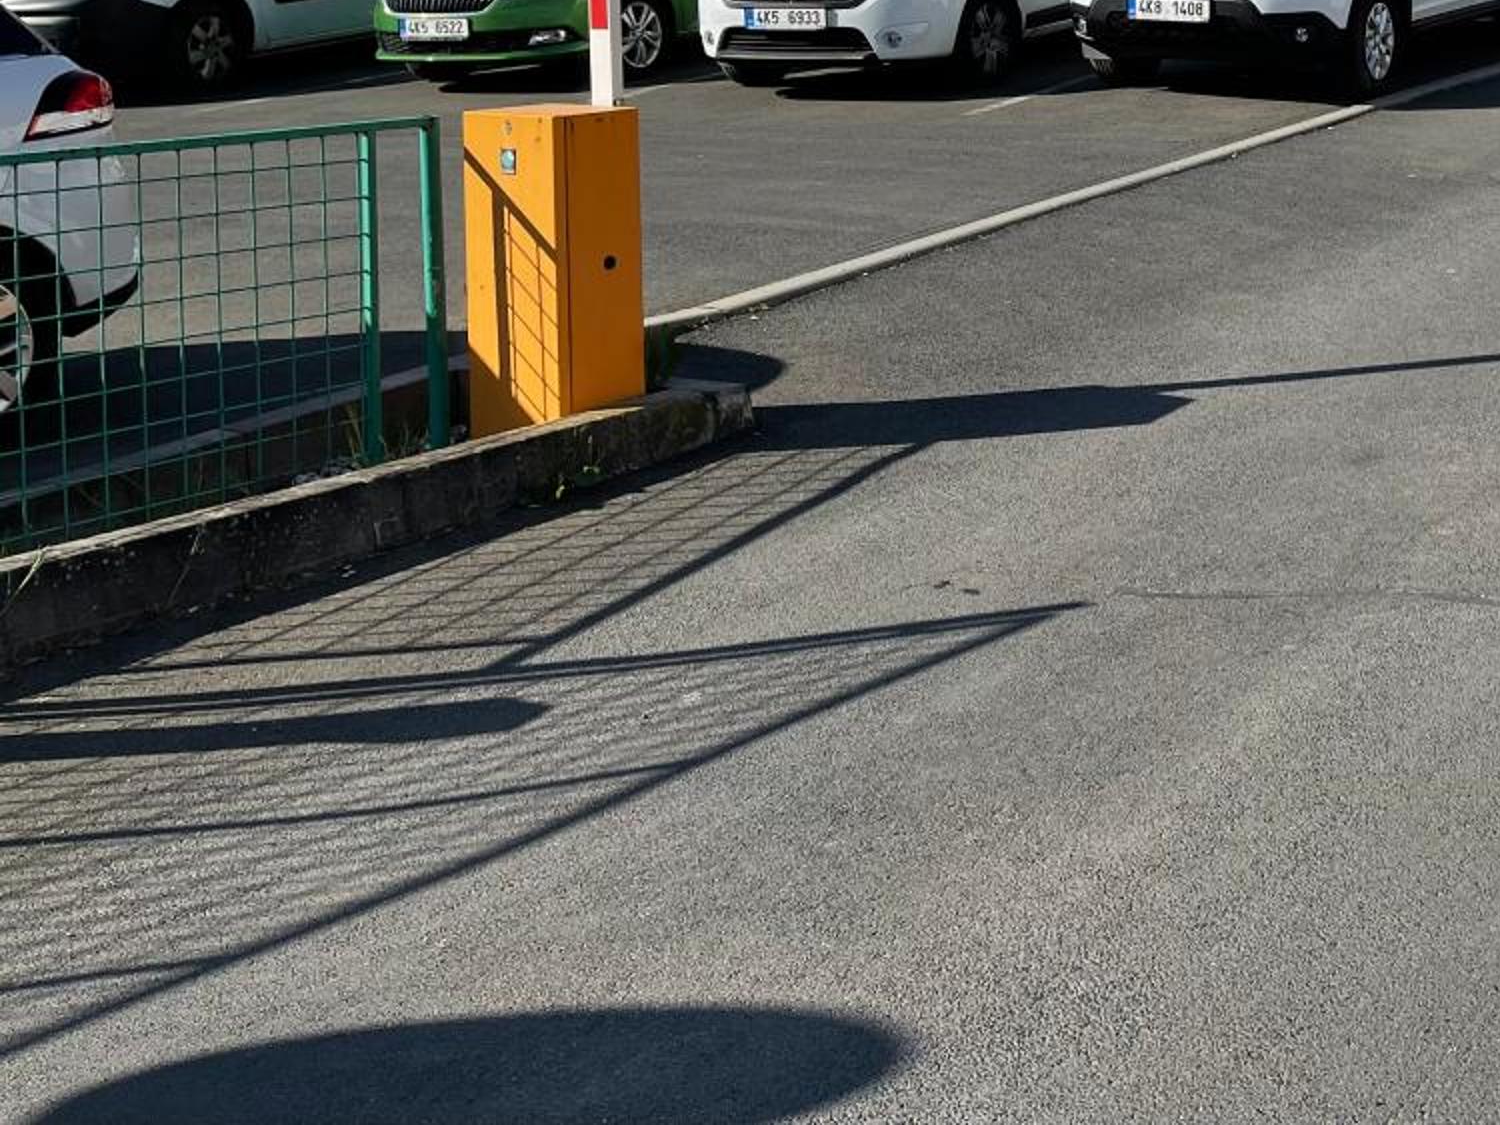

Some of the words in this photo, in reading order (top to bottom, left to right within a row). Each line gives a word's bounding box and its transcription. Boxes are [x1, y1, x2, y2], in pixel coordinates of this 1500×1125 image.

[1138, 0, 1162, 14] 4K8
[1172, 0, 1203, 16] 1408
[757, 10, 780, 24] 4K5
[787, 10, 821, 25] 6933
